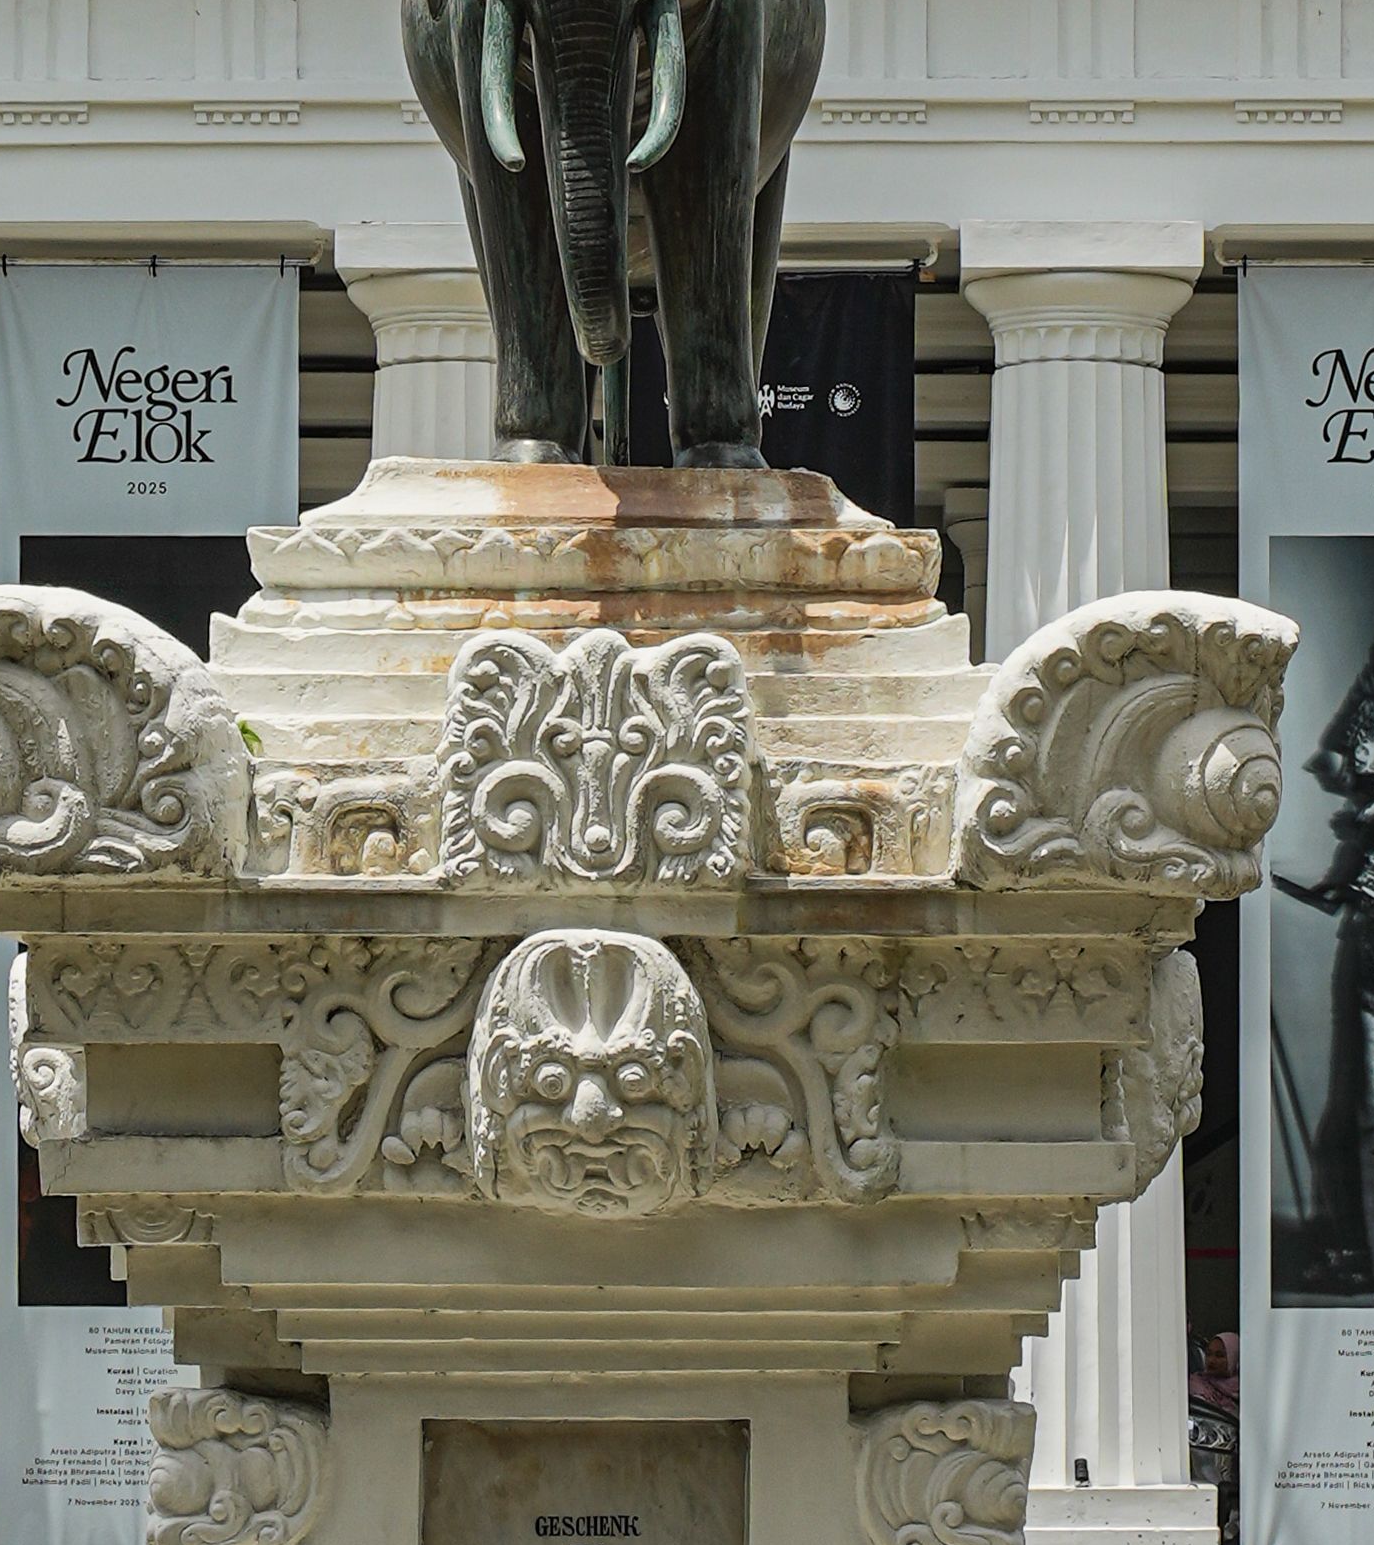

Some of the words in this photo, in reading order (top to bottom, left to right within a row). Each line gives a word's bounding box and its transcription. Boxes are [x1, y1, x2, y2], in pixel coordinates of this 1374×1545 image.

[56, 346, 238, 423] Negeri
[73, 408, 215, 464] Elok
[126, 481, 168, 495] 2025
[116, 1388, 135, 1396] Davy
[1353, 1481, 1374, 1489] Ricky
[535, 1516, 642, 1537] GESCHENK
